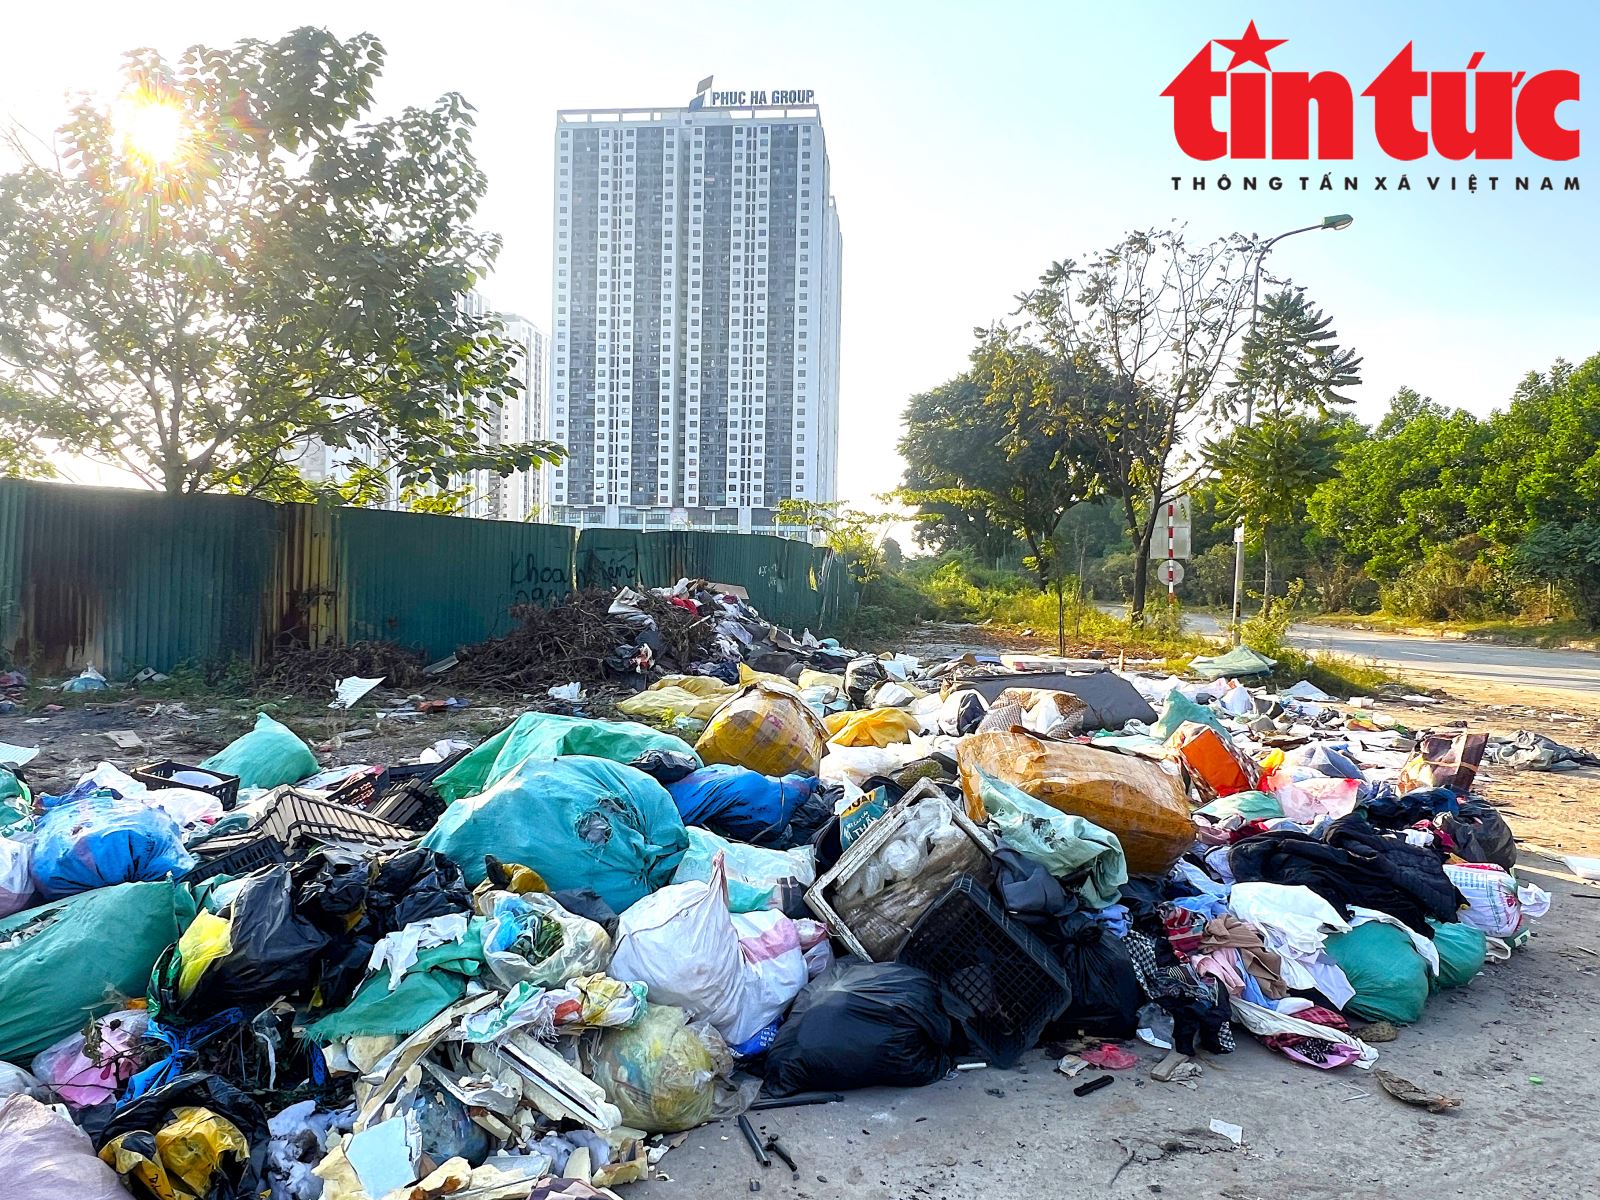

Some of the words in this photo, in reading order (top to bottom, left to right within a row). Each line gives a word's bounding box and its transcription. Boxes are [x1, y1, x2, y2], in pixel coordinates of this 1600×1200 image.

[712, 91, 746, 105] PHUC
[751, 90, 767, 104] HA
[772, 89, 814, 104] GROUP
